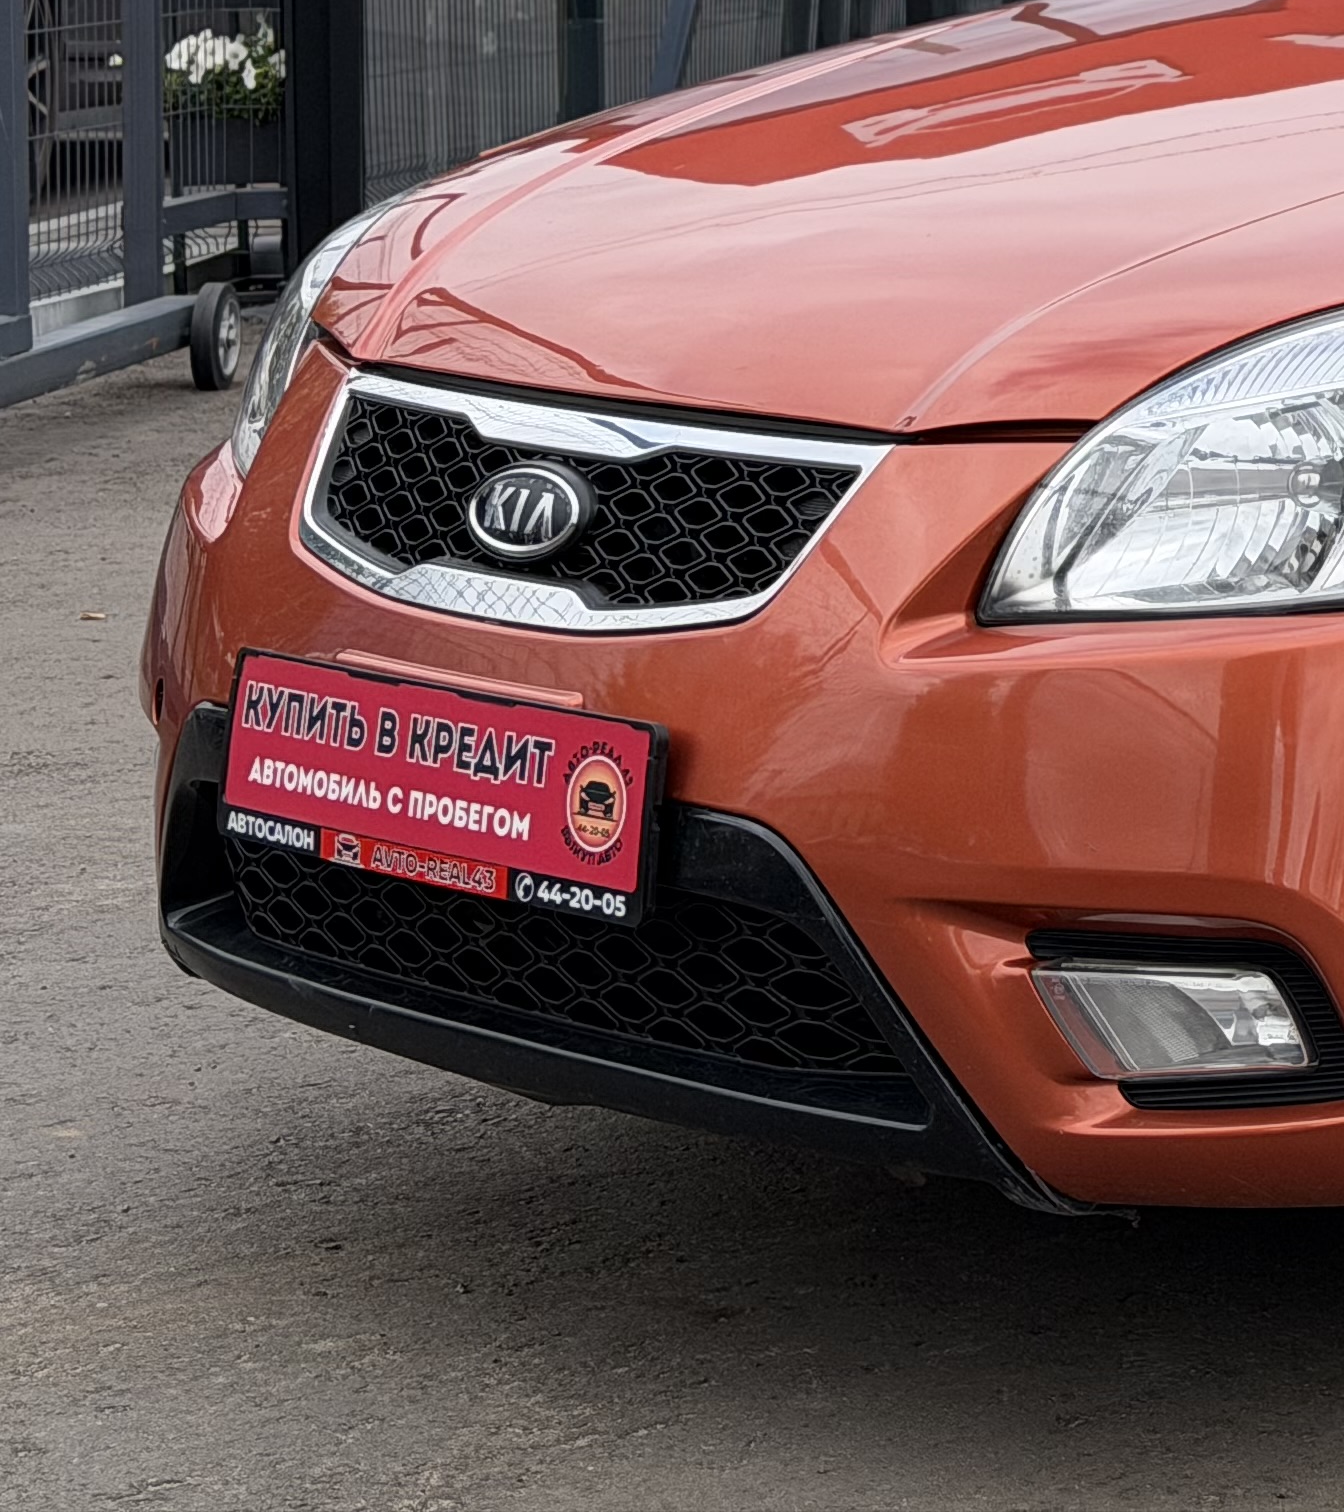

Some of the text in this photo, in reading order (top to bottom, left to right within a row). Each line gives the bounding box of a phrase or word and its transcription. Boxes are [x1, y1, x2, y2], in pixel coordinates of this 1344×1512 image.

[483, 482, 555, 542] KIA
[241, 681, 556, 788] КУПИТЬ В КРЕДИТ
[247, 755, 532, 842] АВТОМОБИЛЬ С ПРОБЕГОМ
[226, 810, 315, 852] АВТОСАЛОН
[371, 844, 497, 893] AVTO-REAL43
[536, 881, 627, 918] 44-20-05
